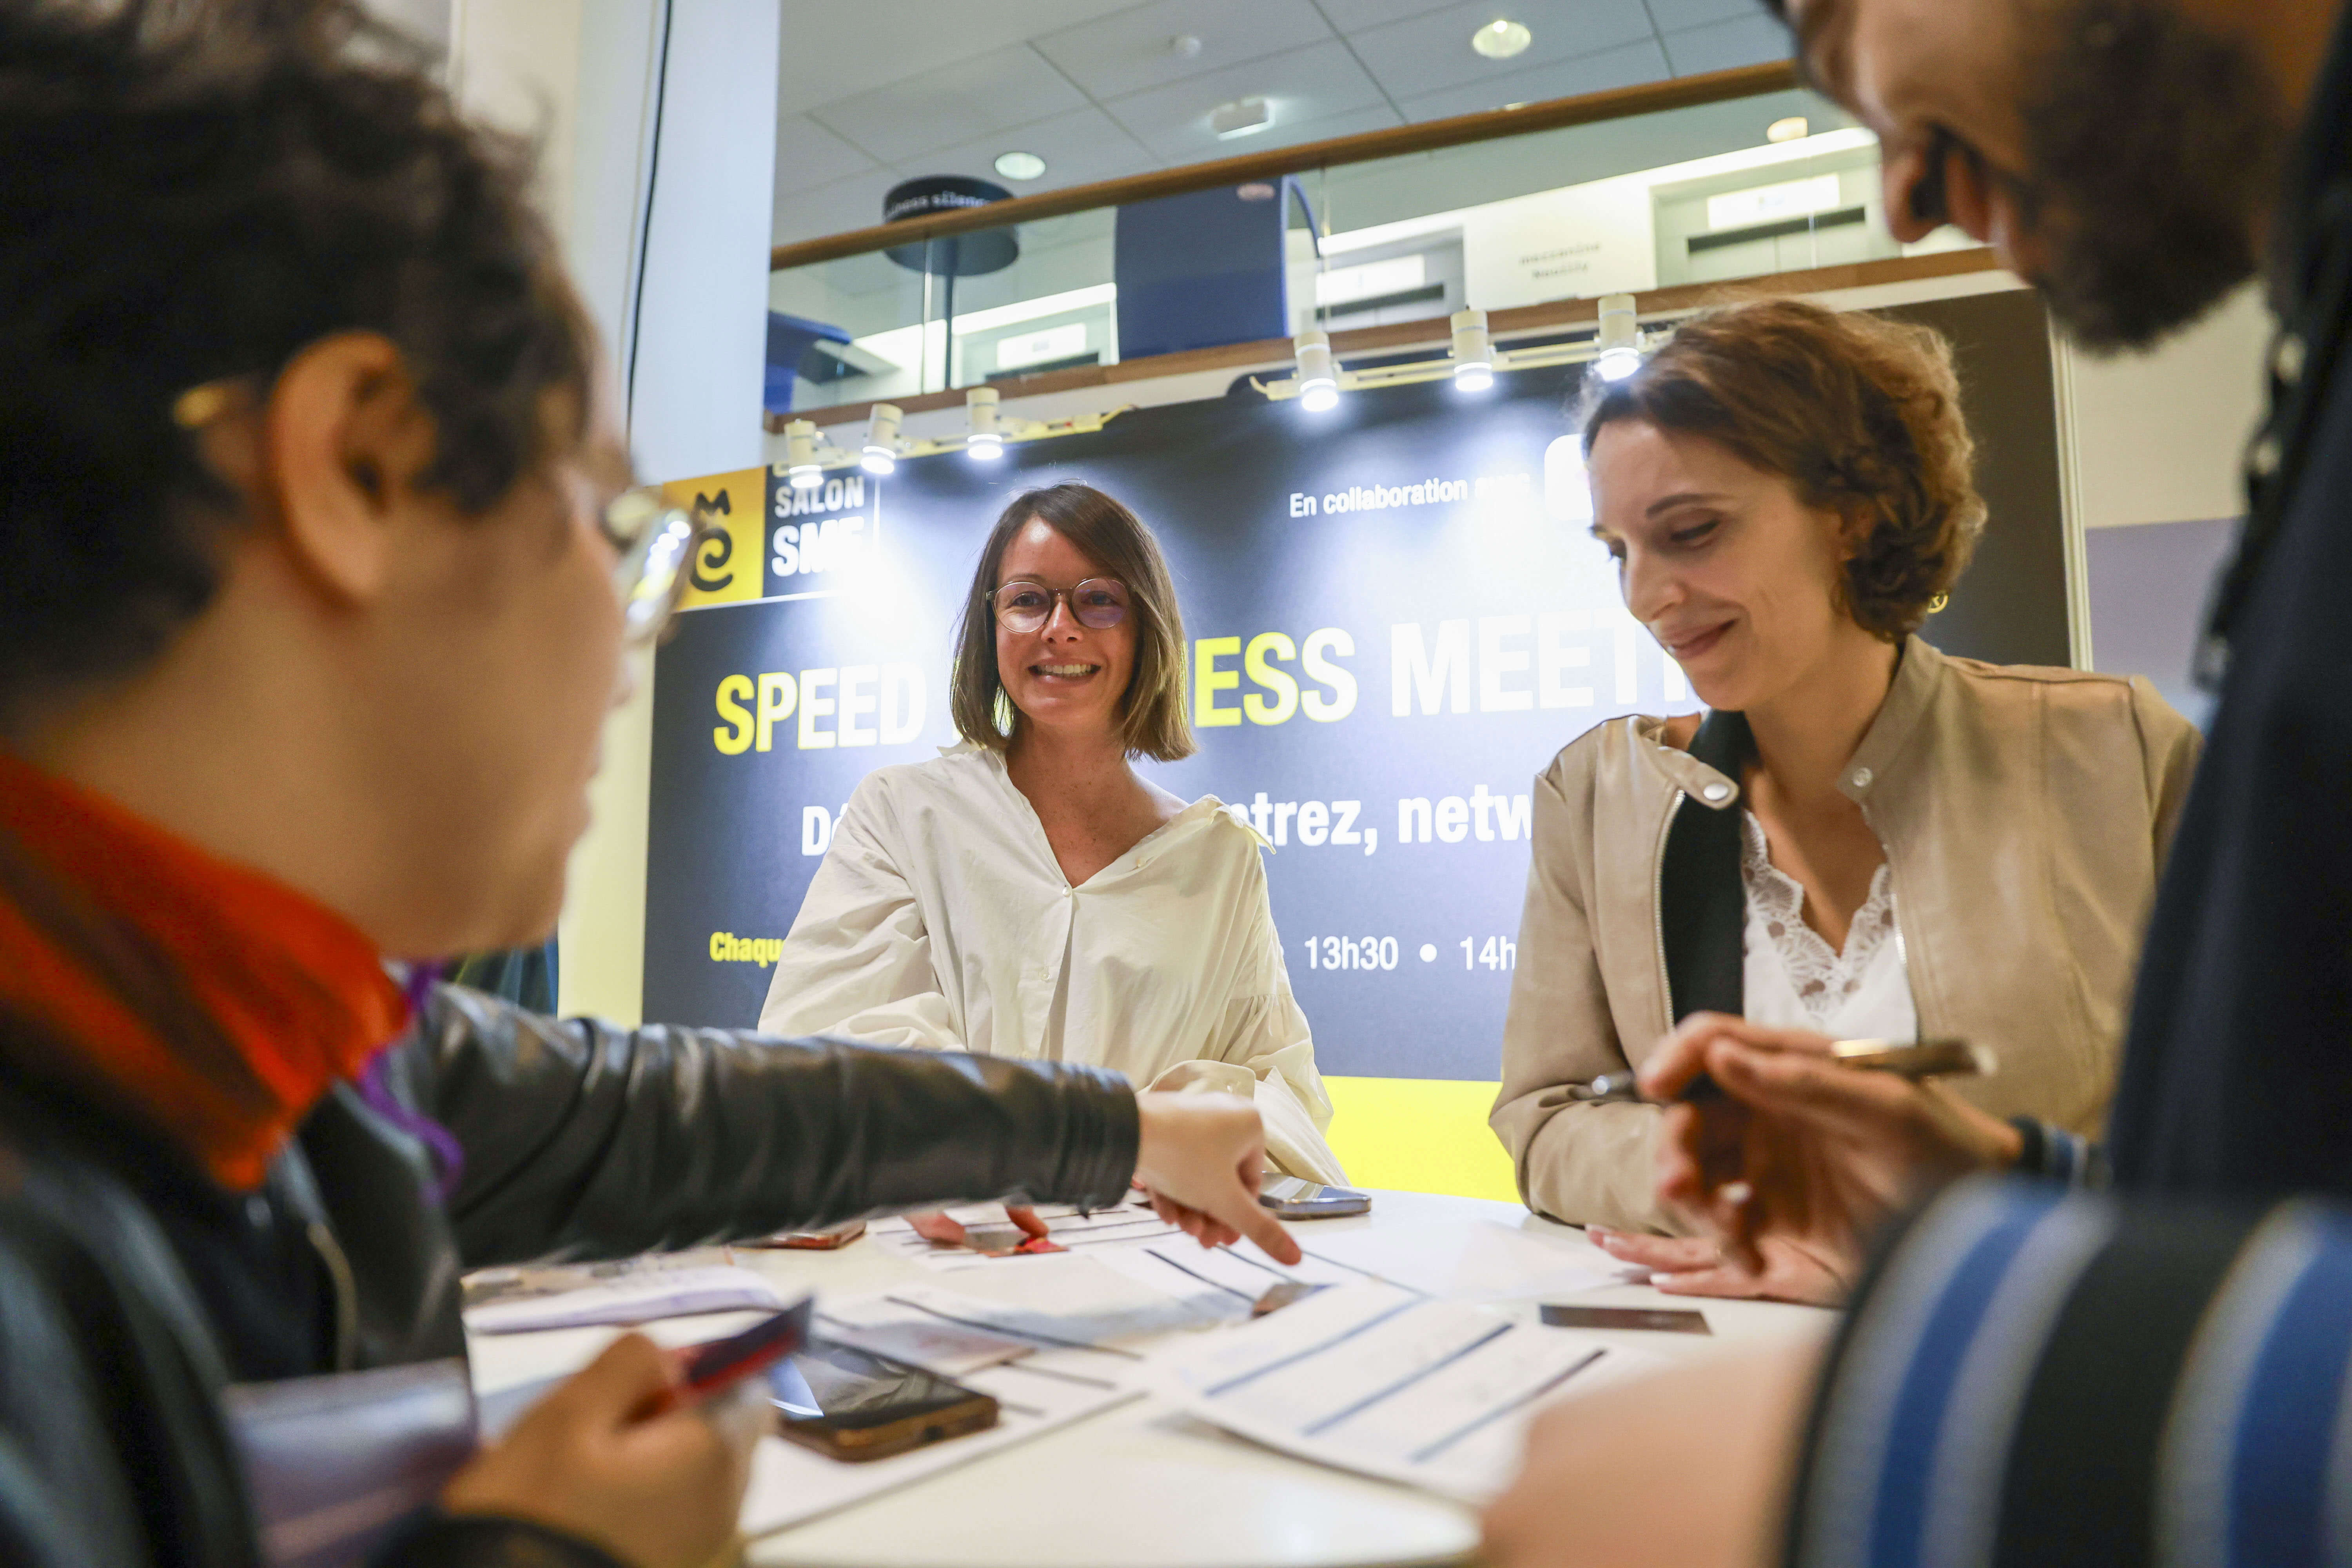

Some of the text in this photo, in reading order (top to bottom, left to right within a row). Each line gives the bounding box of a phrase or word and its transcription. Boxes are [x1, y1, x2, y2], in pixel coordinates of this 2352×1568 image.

[775, 475, 865, 518] SALON
[1289, 492, 1317, 518] En
[1323, 477, 1468, 515] collaboration
[713, 661, 927, 755] SPEED
[1180, 627, 1359, 728] ESS
[1304, 935, 1399, 971] 13h30
[1459, 935, 1517, 971] 14h
